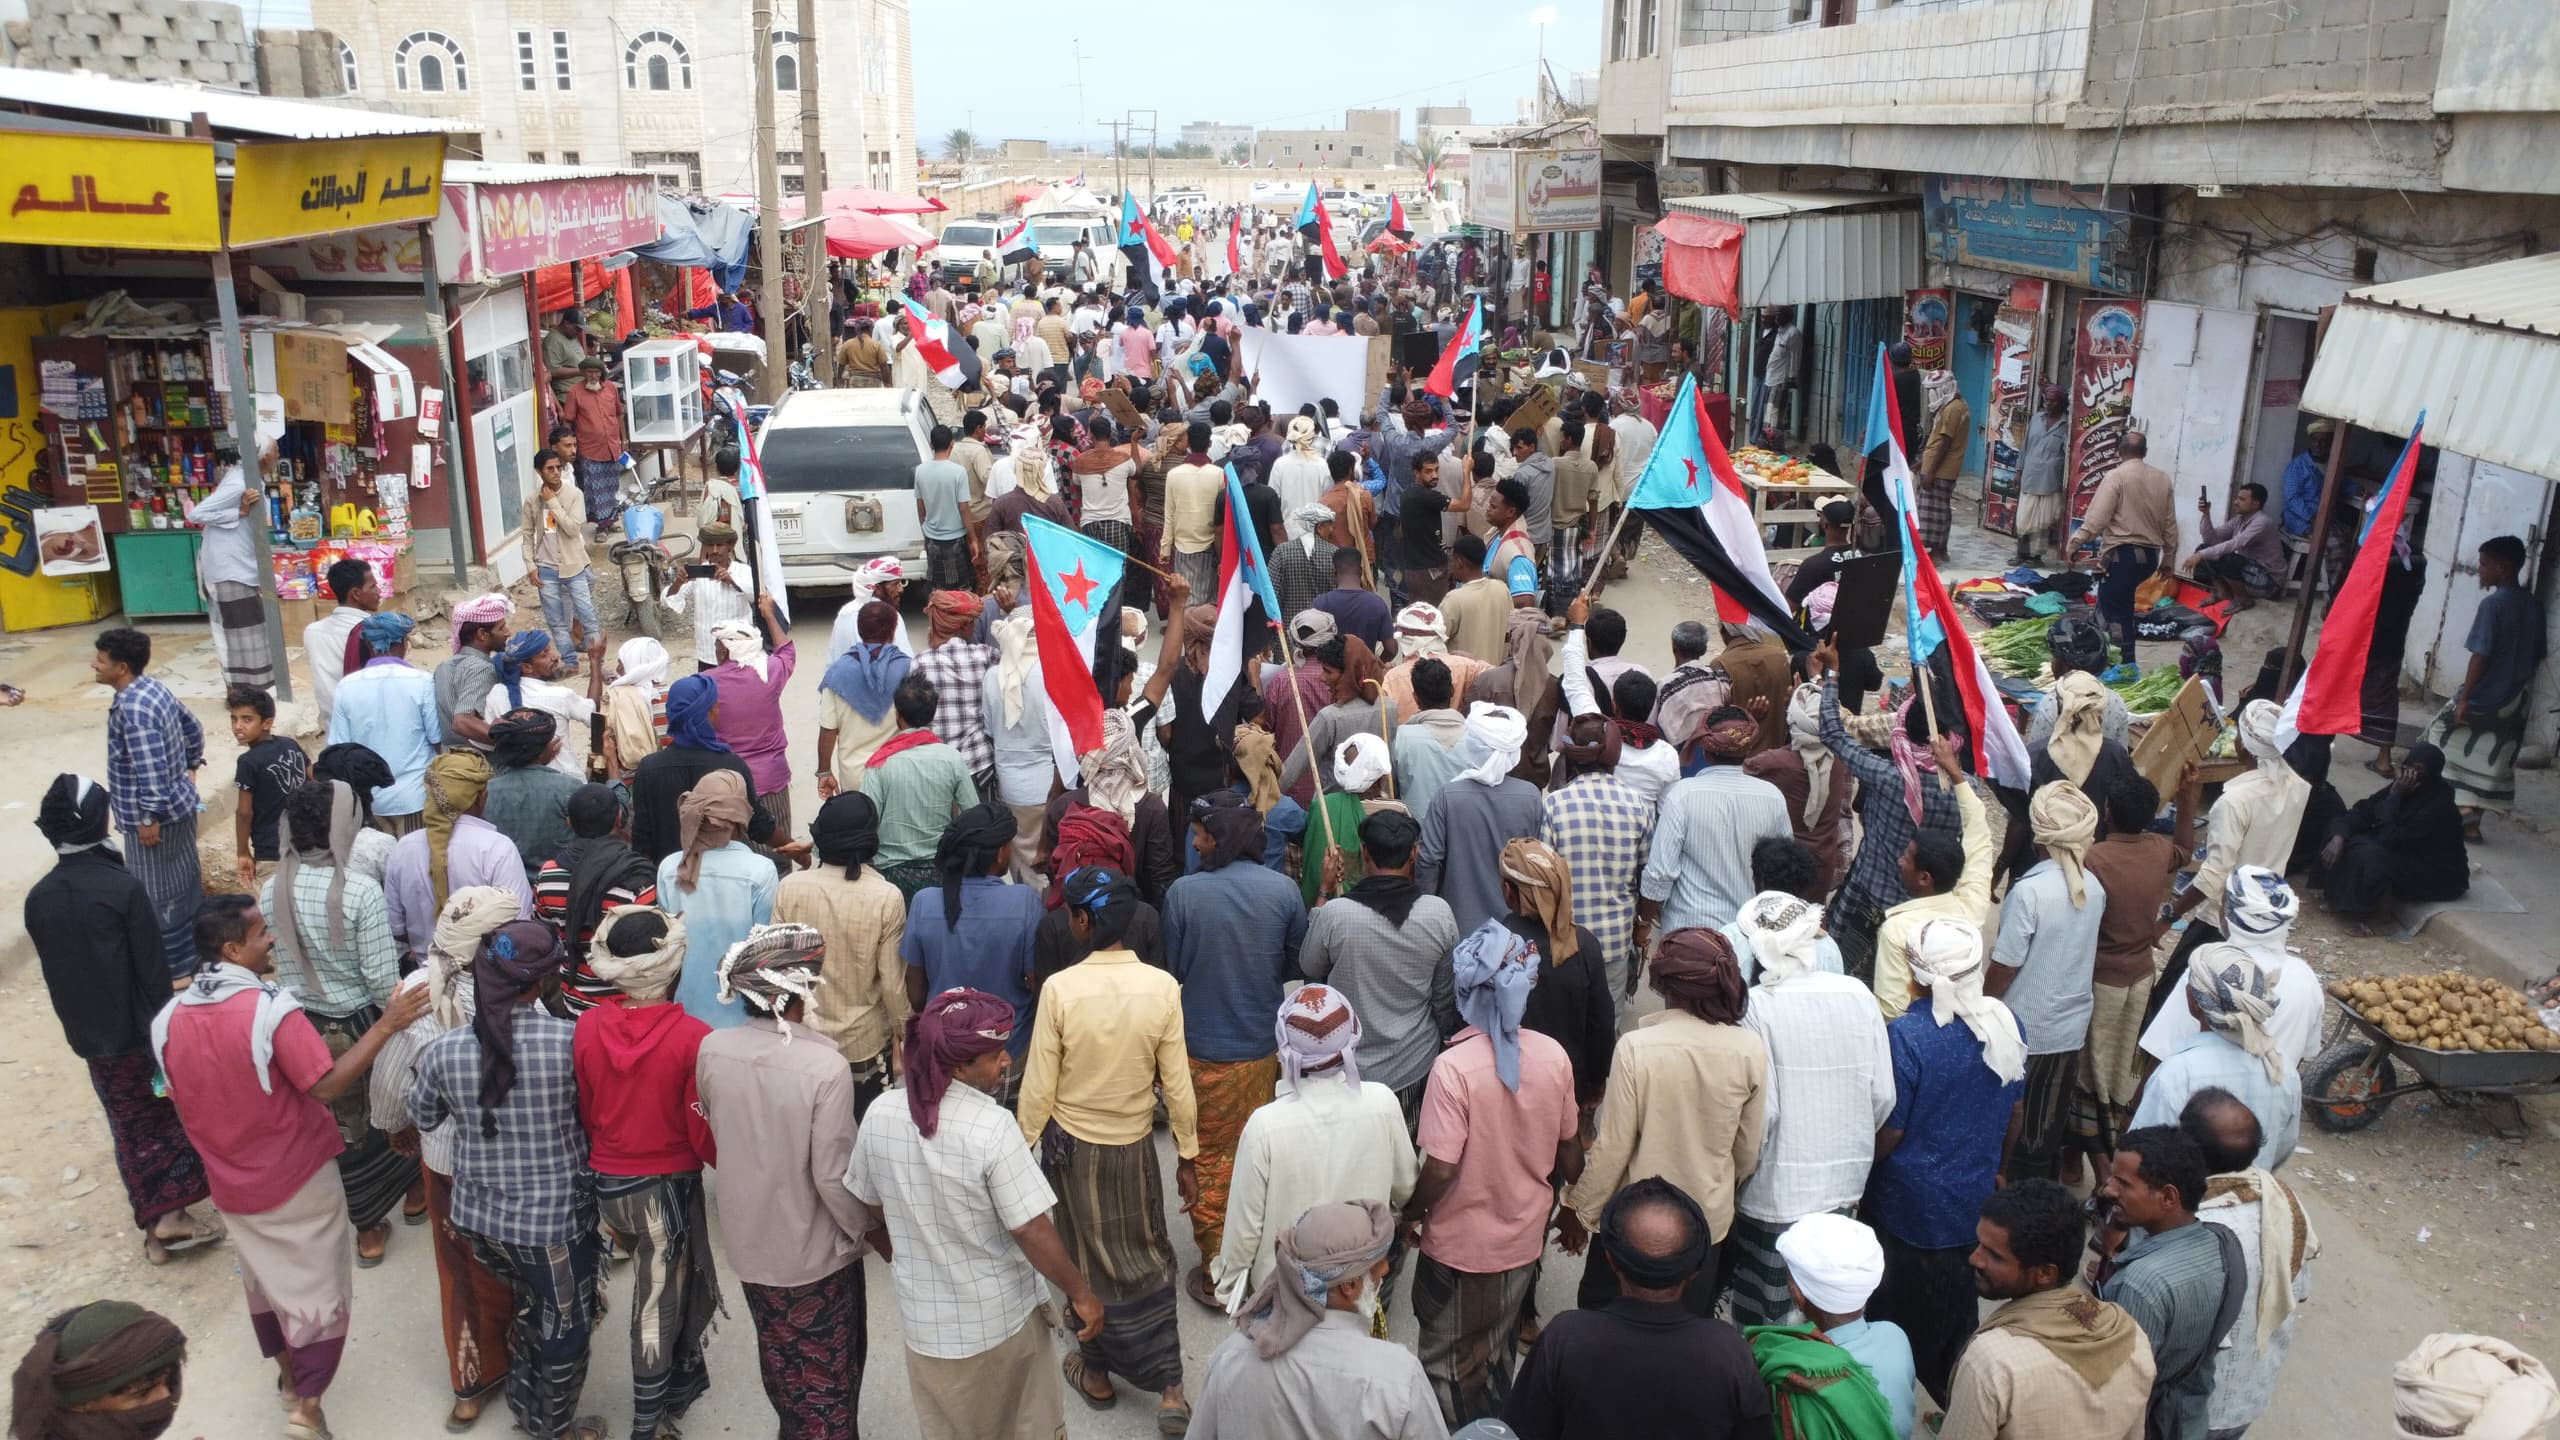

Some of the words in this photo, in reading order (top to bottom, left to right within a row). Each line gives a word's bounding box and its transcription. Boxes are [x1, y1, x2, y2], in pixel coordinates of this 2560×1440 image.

[10, 175, 172, 217] عالم
[379, 166, 432, 206] عالم
[1536, 281, 1544, 292] 9
[2081, 357, 2134, 408] موبايل
